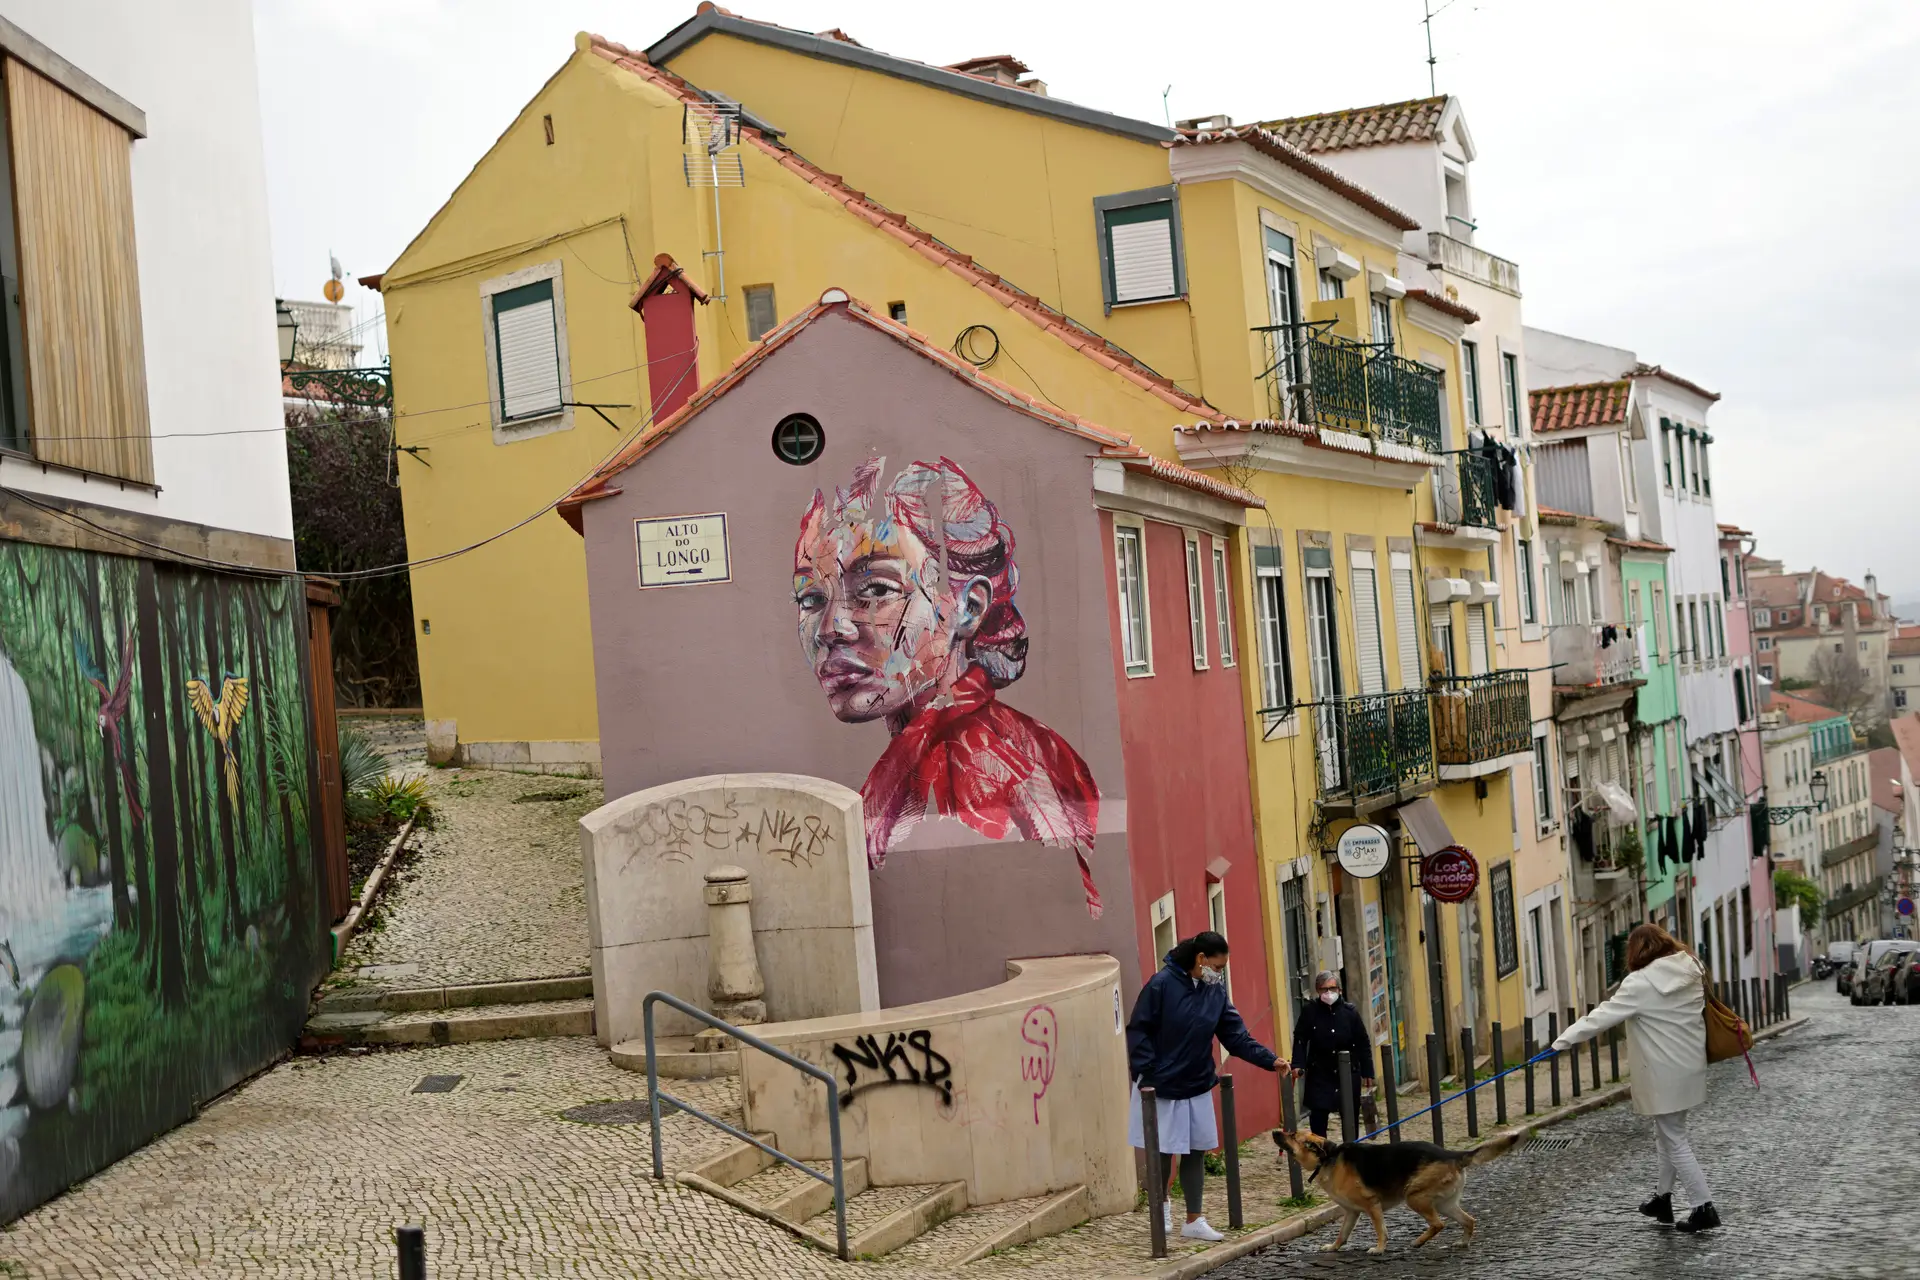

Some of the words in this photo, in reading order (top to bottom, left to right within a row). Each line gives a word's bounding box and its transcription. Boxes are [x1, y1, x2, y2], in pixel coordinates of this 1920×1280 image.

[665, 523, 698, 537] ALTO
[675, 538, 690, 546] DO
[657, 548, 710, 567] LONGO
[1435, 863, 1459, 872] Los
[1423, 872, 1475, 883] Manolos
